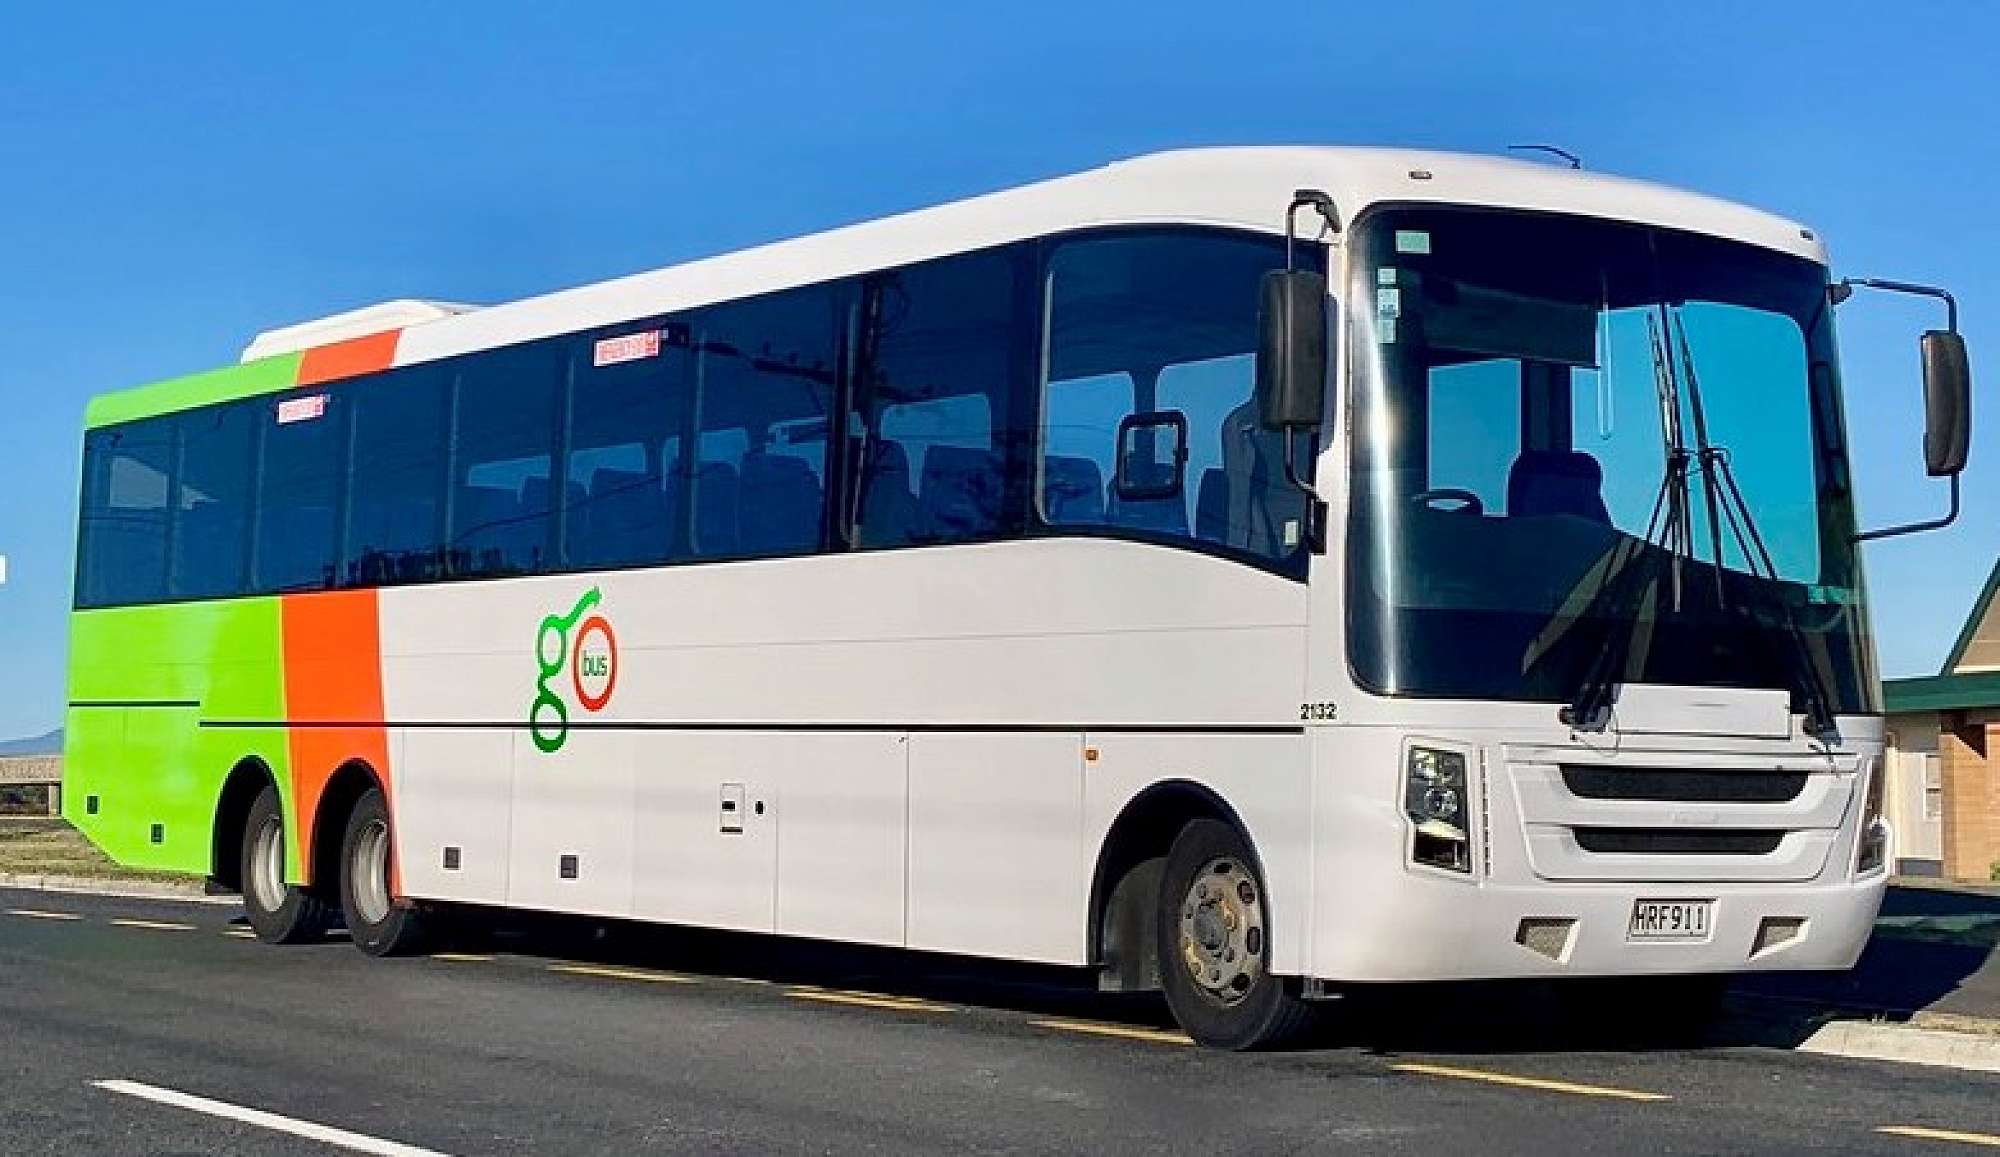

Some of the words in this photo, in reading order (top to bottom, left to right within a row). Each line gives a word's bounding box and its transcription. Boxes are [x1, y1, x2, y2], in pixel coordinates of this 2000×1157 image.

[530, 586, 617, 752] go
[582, 650, 608, 676] bus
[1300, 703, 1337, 719] 2132
[1633, 906, 1704, 930] HRF911
